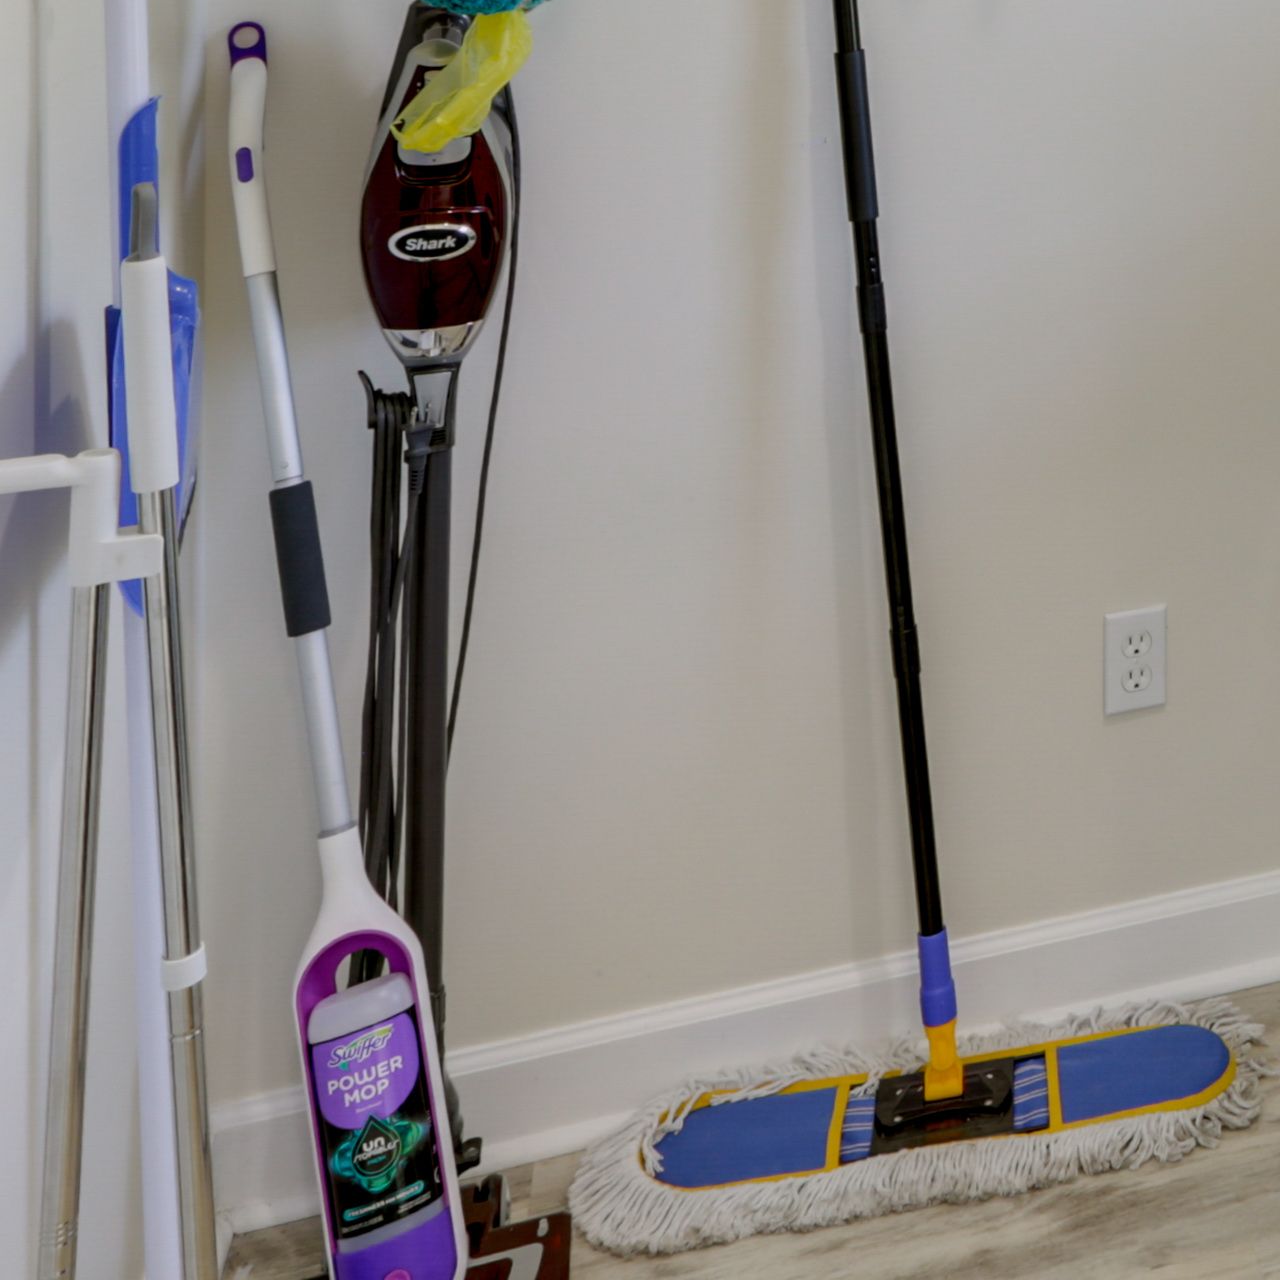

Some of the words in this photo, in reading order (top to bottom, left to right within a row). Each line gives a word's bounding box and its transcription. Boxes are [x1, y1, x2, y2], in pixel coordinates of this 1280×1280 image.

[404, 235, 457, 251] Shark
[328, 1026, 394, 1068] Swiffer
[328, 1055, 404, 1095] POWER
[345, 1078, 391, 1108] MOP
